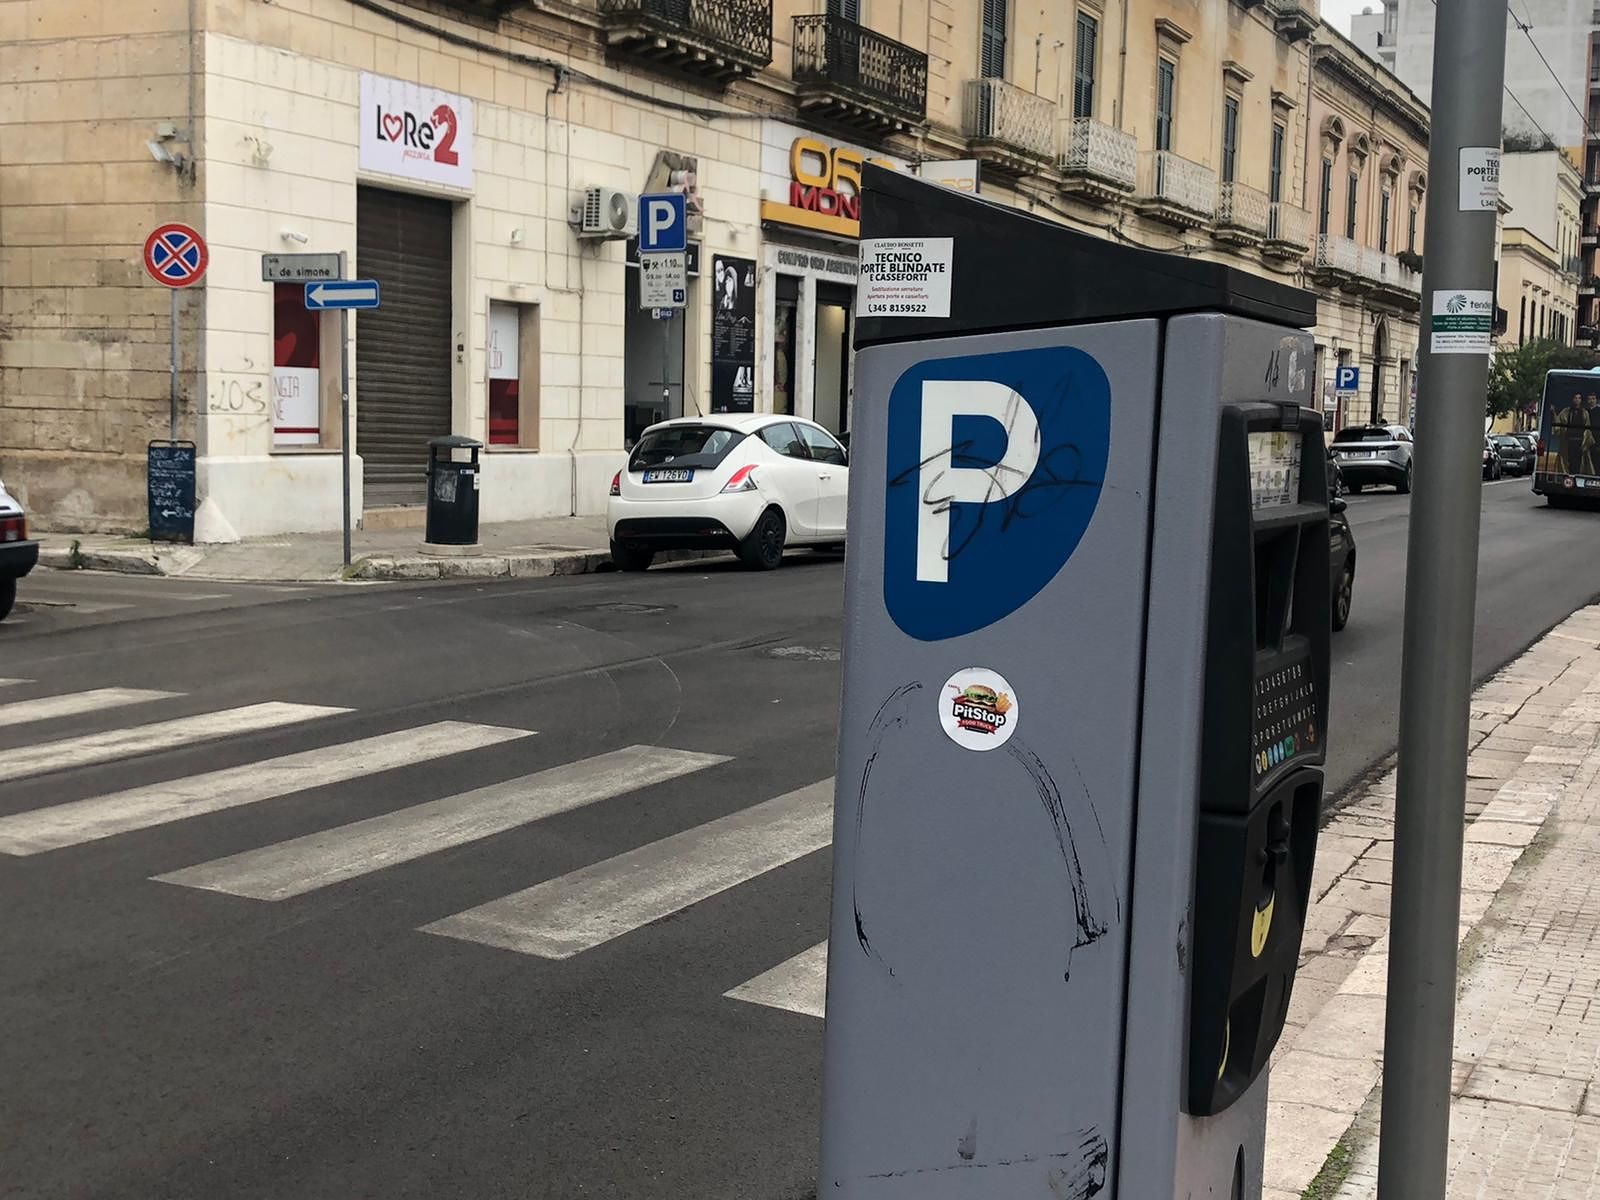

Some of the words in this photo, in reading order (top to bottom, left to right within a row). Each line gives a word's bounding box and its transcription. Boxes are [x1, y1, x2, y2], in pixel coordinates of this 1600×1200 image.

[648, 200, 676, 246] P
[875, 253, 922, 263] TECNICO
[279, 266, 291, 277] de
[296, 266, 330, 277] simone
[860, 263, 886, 275] PORTE
[889, 263, 945, 273] BLINDATE
[875, 273, 928, 281] CASSEFORTI
[873, 304, 887, 312] 345
[889, 304, 927, 312] 8159522
[916, 380, 1041, 583] P
[954, 705, 1005, 727] PitStop
